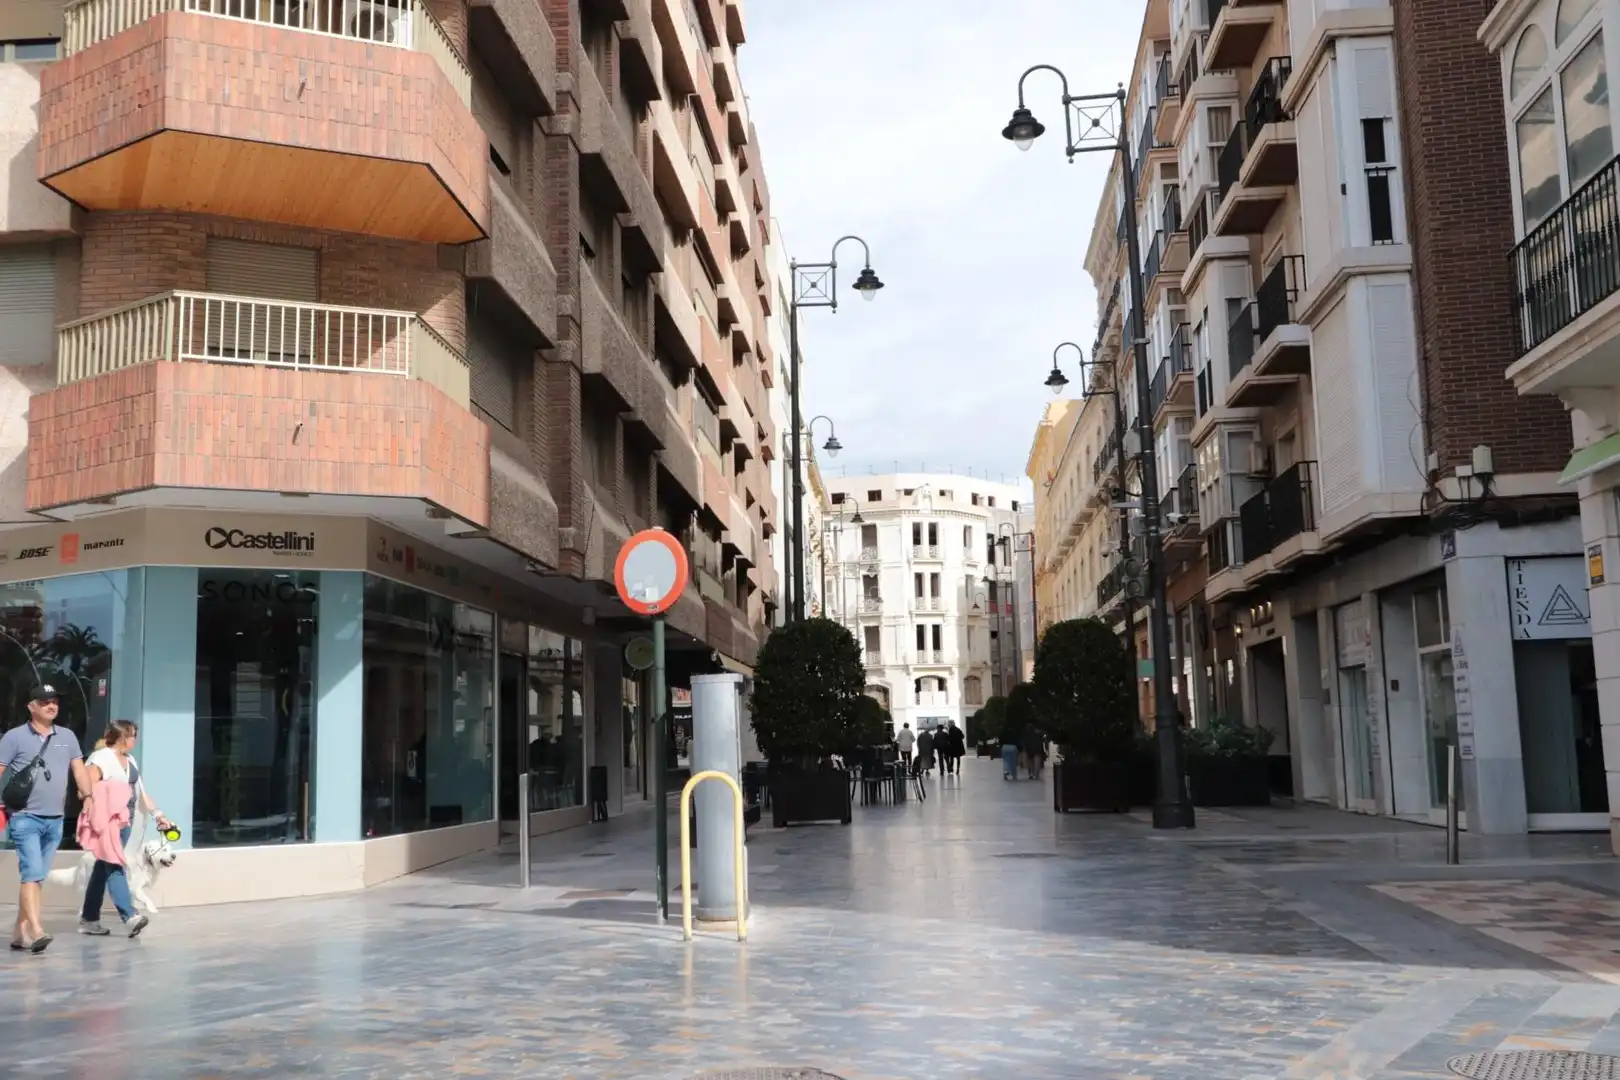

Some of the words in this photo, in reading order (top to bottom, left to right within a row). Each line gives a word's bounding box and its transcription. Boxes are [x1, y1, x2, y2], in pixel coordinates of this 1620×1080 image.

[84, 538, 125, 551] marantz
[227, 529, 315, 551] Castellini
[14, 545, 55, 560] BOSE
[203, 580, 317, 604] SONOS
[1512, 560, 1533, 639] TIENDA
